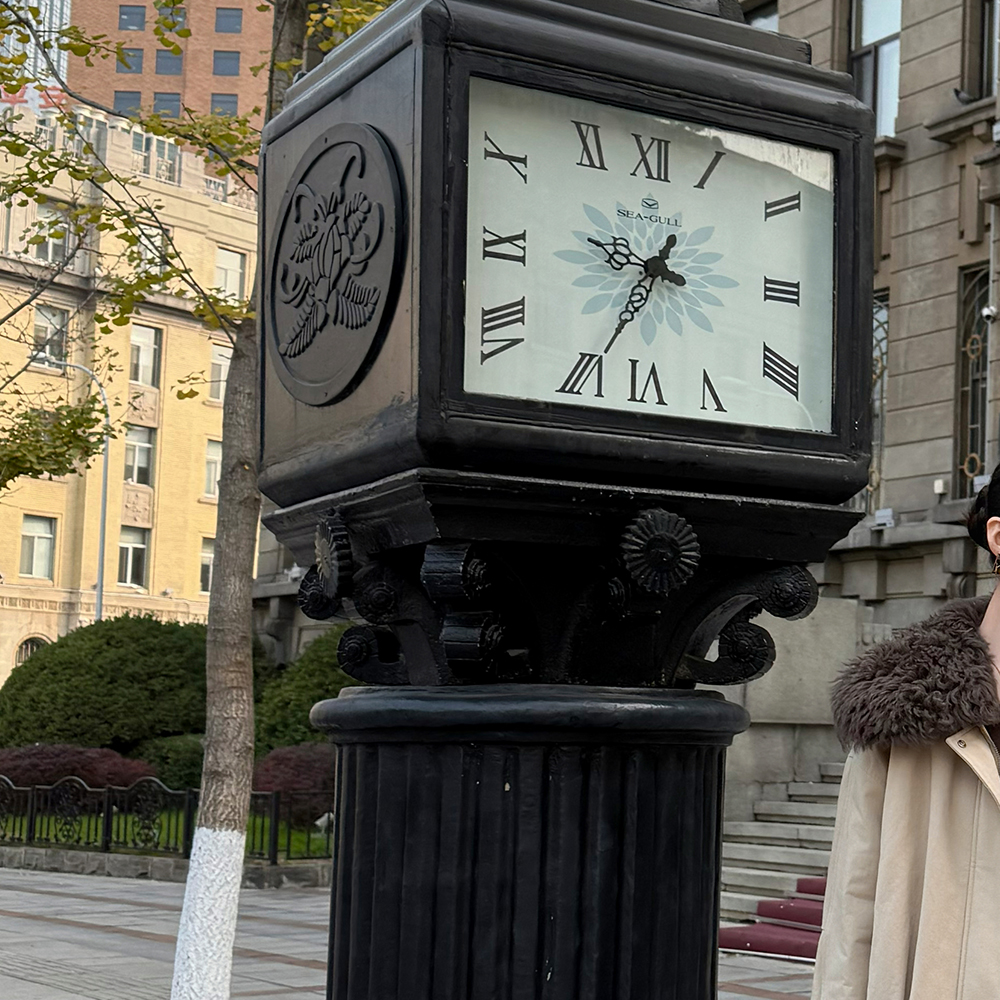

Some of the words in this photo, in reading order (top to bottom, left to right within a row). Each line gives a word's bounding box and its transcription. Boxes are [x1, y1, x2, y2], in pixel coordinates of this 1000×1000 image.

[484, 131, 528, 184] X
[570, 119, 609, 172] XI
[630, 132, 672, 183] XII
[693, 150, 727, 190] I
[616, 208, 682, 228] SEA-GULL
[764, 190, 801, 222] II
[482, 225, 527, 267] IX
[763, 275, 801, 307] III
[480, 295, 526, 366] VIII
[554, 352, 605, 398] VII
[627, 358, 668, 406] VI
[700, 368, 728, 413] V
[762, 341, 800, 402] IIII
